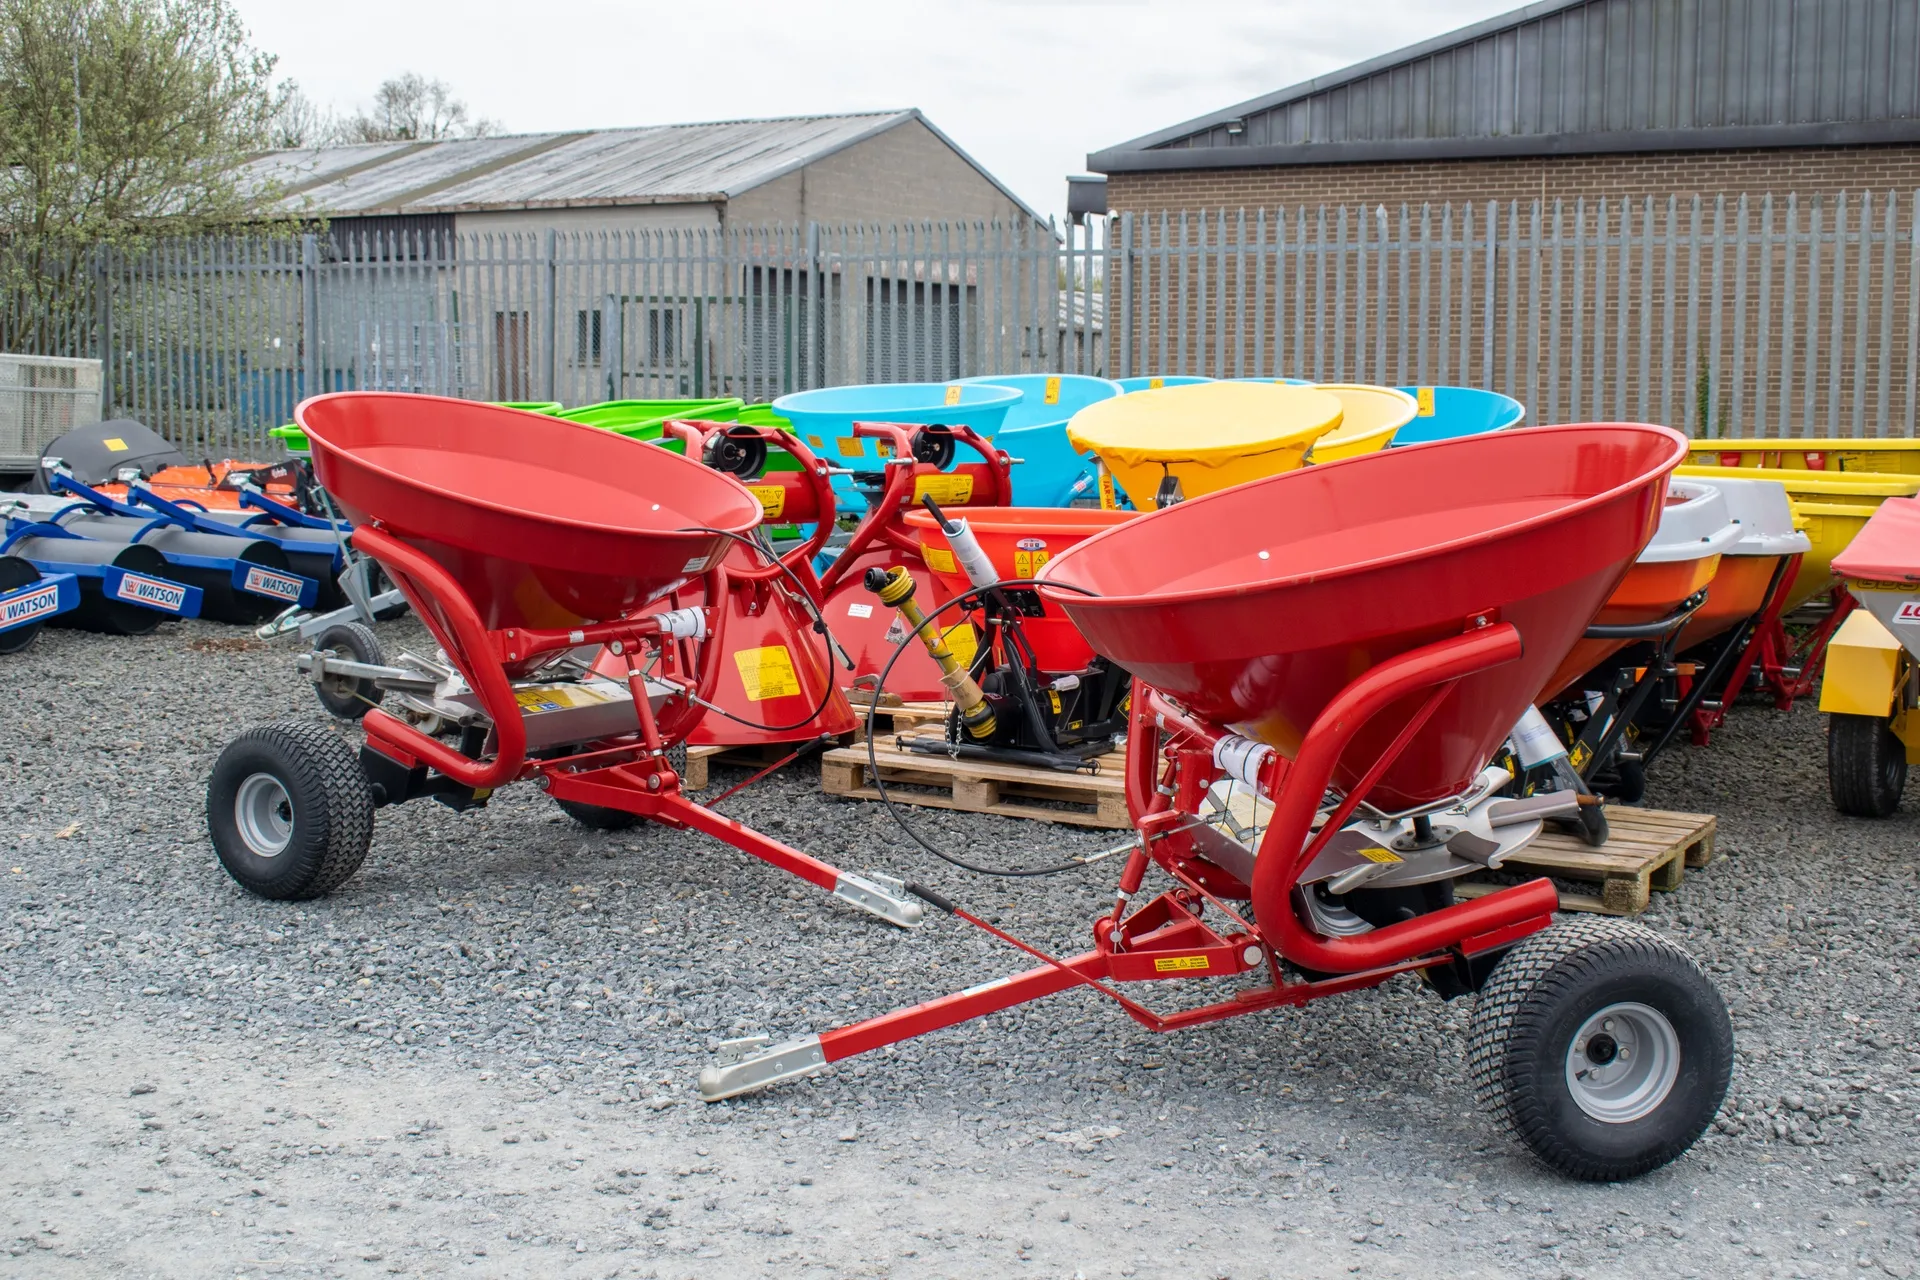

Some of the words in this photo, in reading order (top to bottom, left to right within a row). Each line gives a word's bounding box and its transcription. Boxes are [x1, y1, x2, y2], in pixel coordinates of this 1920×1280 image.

[139, 583, 182, 605] WATSON
[262, 576, 301, 596] WATSON
[7, 591, 56, 619] WATSON
